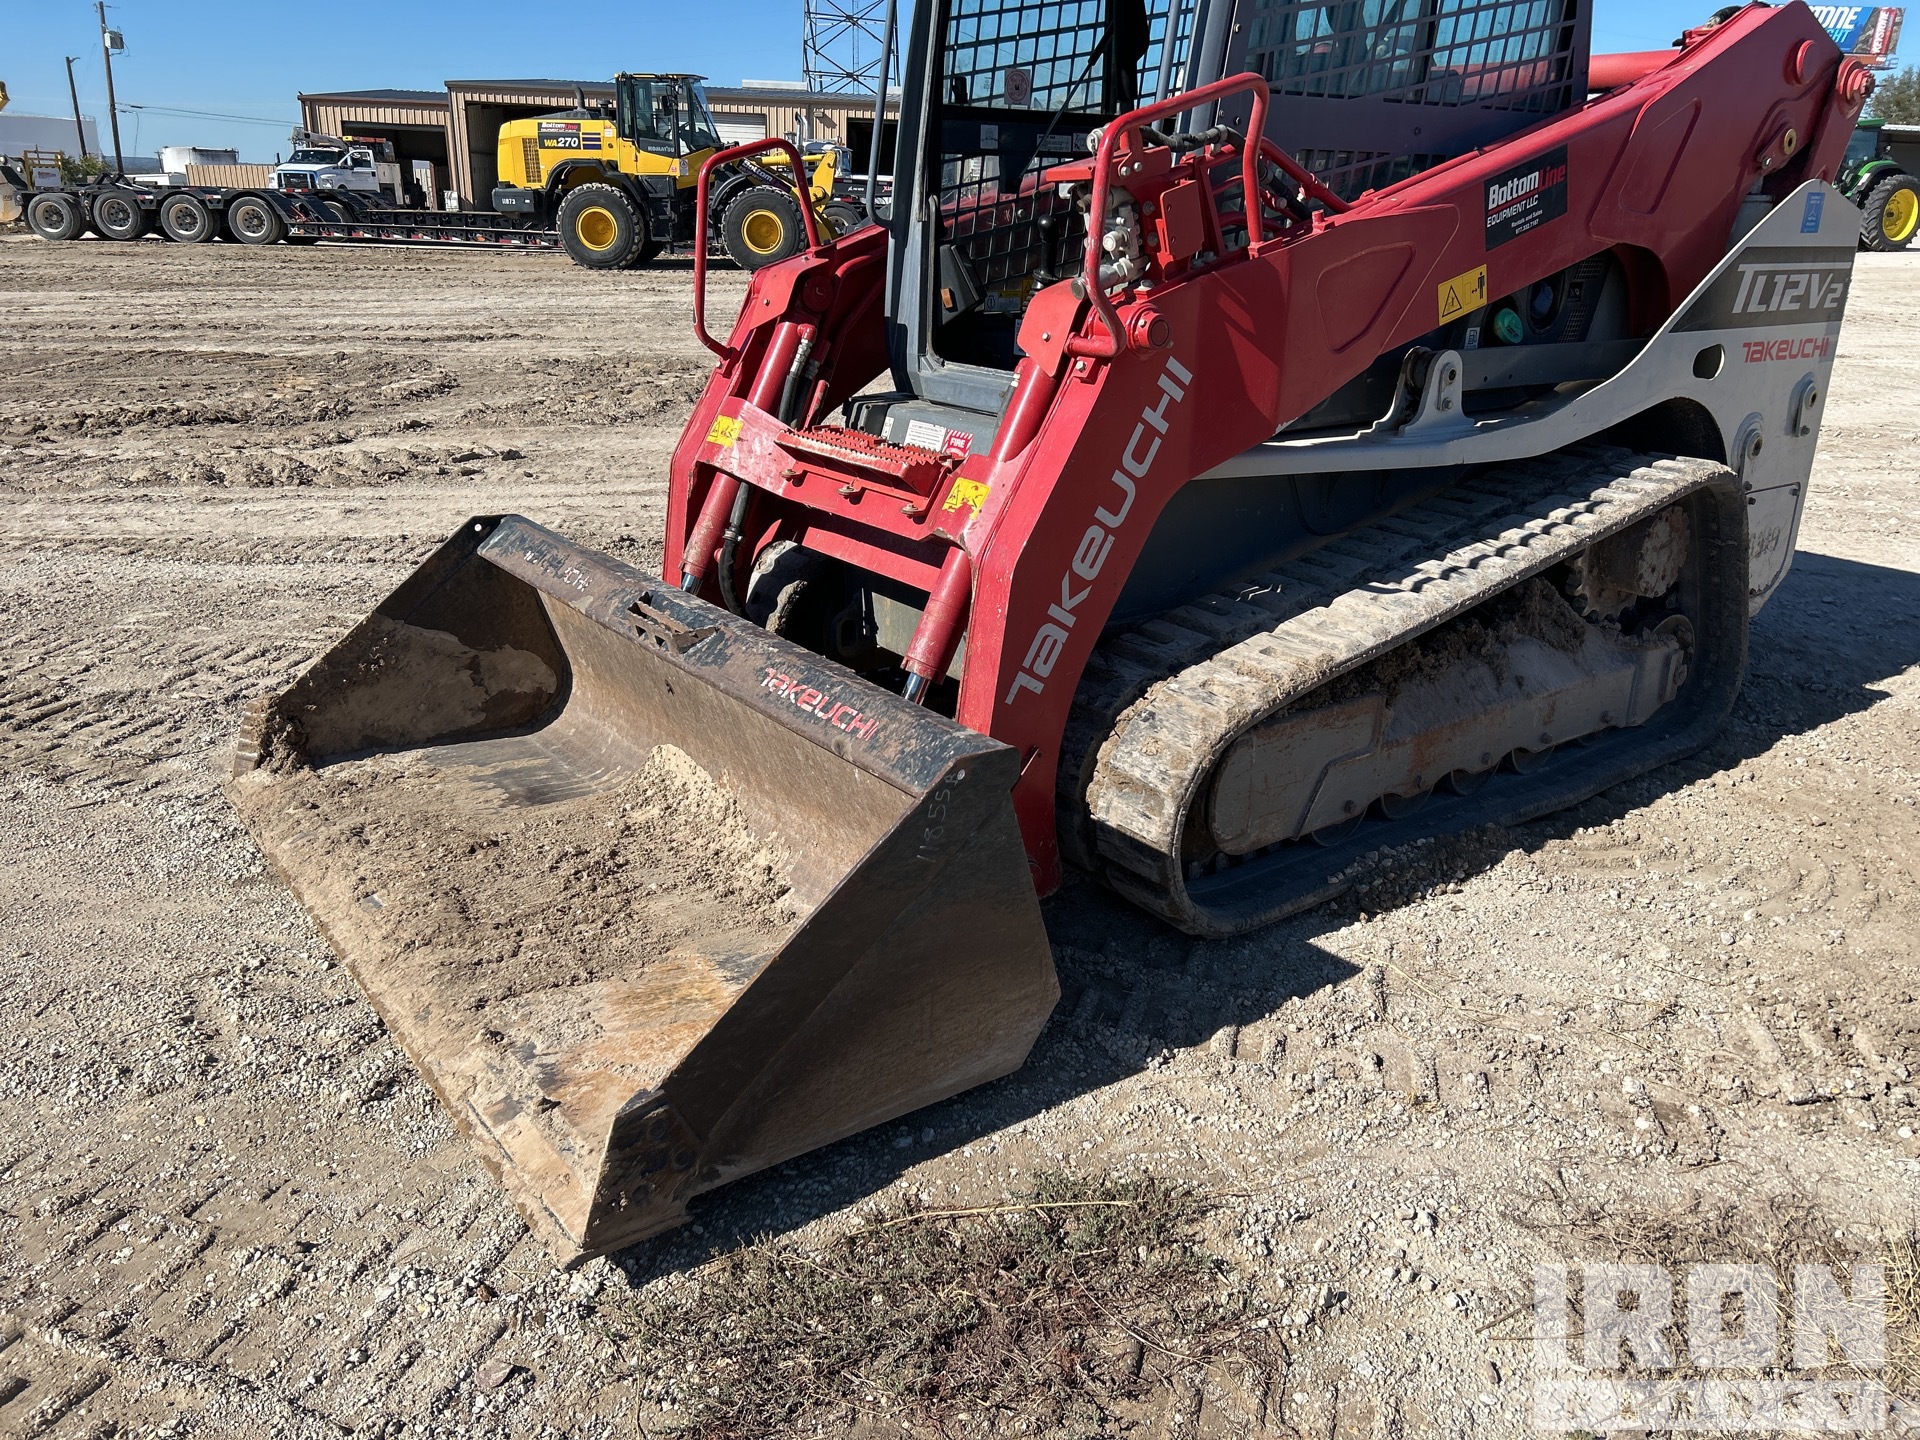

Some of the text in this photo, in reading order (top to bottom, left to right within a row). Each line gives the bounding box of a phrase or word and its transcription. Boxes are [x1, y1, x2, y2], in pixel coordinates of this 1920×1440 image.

[543, 137, 579, 148] WA270
[647, 145, 675, 153] KOMATSU
[1486, 194, 1539, 227] EQUIPMENT LLC
[1731, 260, 1853, 314] TL12V2
[949, 436, 966, 449] FIRE
